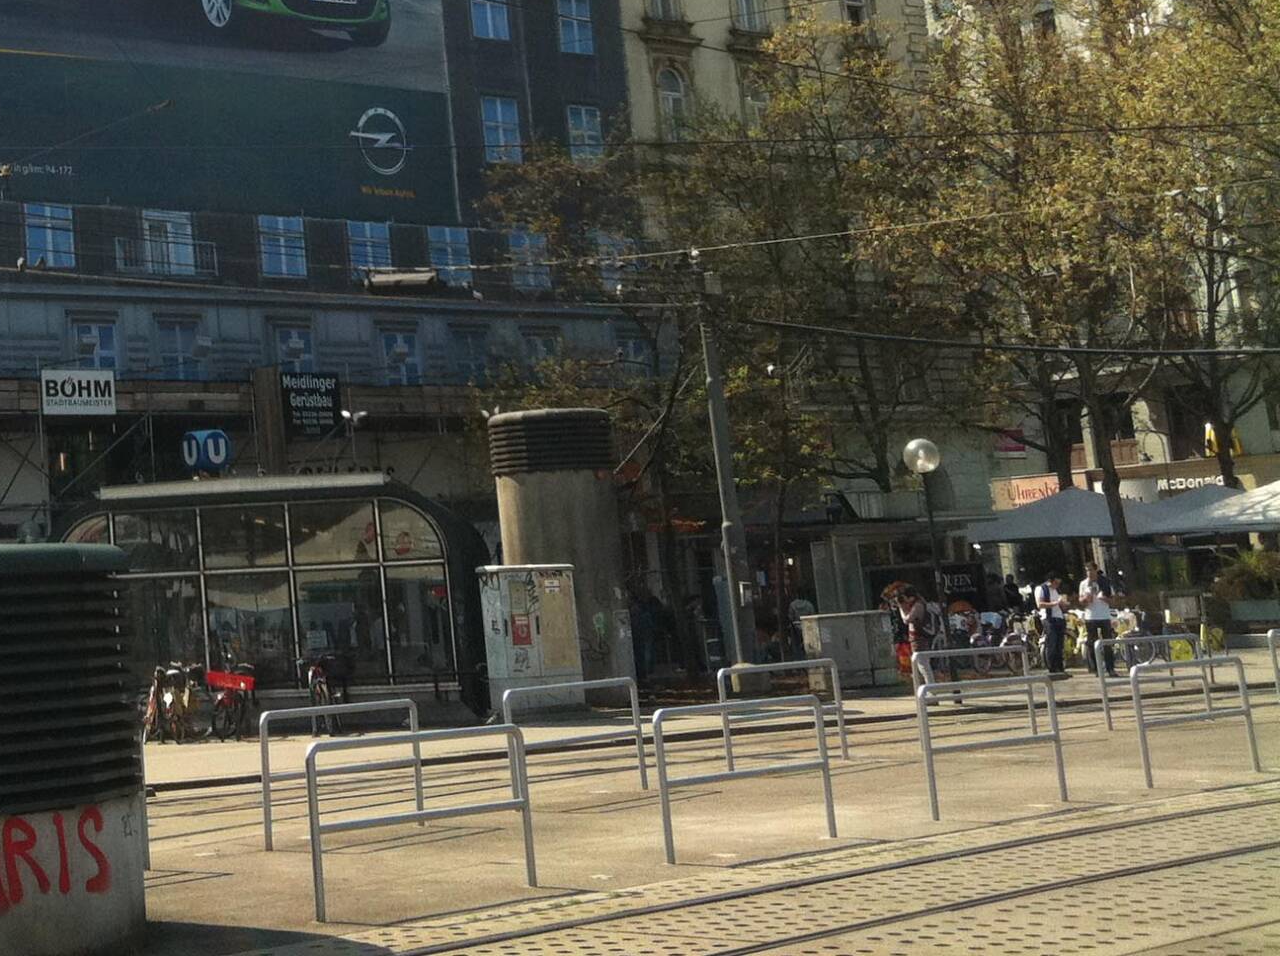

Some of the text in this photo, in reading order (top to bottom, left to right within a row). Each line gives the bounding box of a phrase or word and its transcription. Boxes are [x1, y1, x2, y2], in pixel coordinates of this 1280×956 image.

[45, 375, 112, 398] BÖHM
[282, 374, 336, 392] Meidlinger
[289, 391, 333, 407] Gerüstbau
[183, 439, 198, 467] U
[207, 438, 227, 464] U
